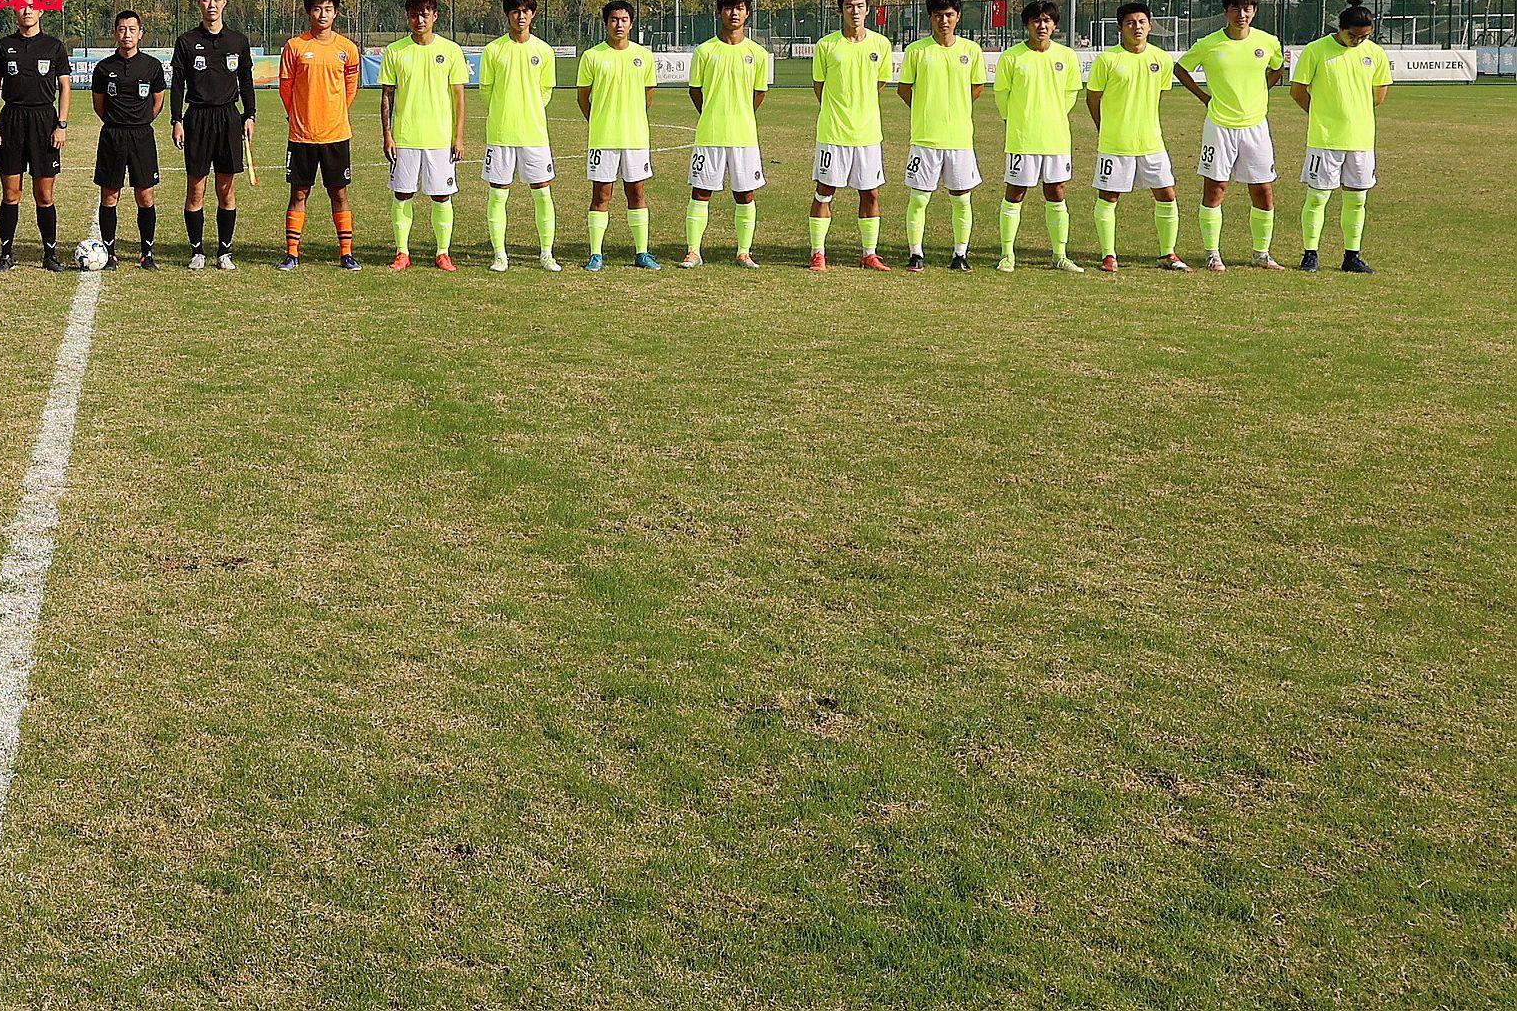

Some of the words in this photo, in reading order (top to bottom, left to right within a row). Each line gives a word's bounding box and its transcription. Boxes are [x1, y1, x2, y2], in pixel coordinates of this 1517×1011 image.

[1407, 61, 1464, 70] LUMENIZER
[589, 148, 602, 166] 26
[692, 153, 705, 172] 23
[820, 149, 832, 169] 10
[1009, 152, 1022, 171] 12
[1201, 145, 1215, 163] 33
[1309, 154, 1321, 173] 11
[1100, 157, 1113, 176] 16
